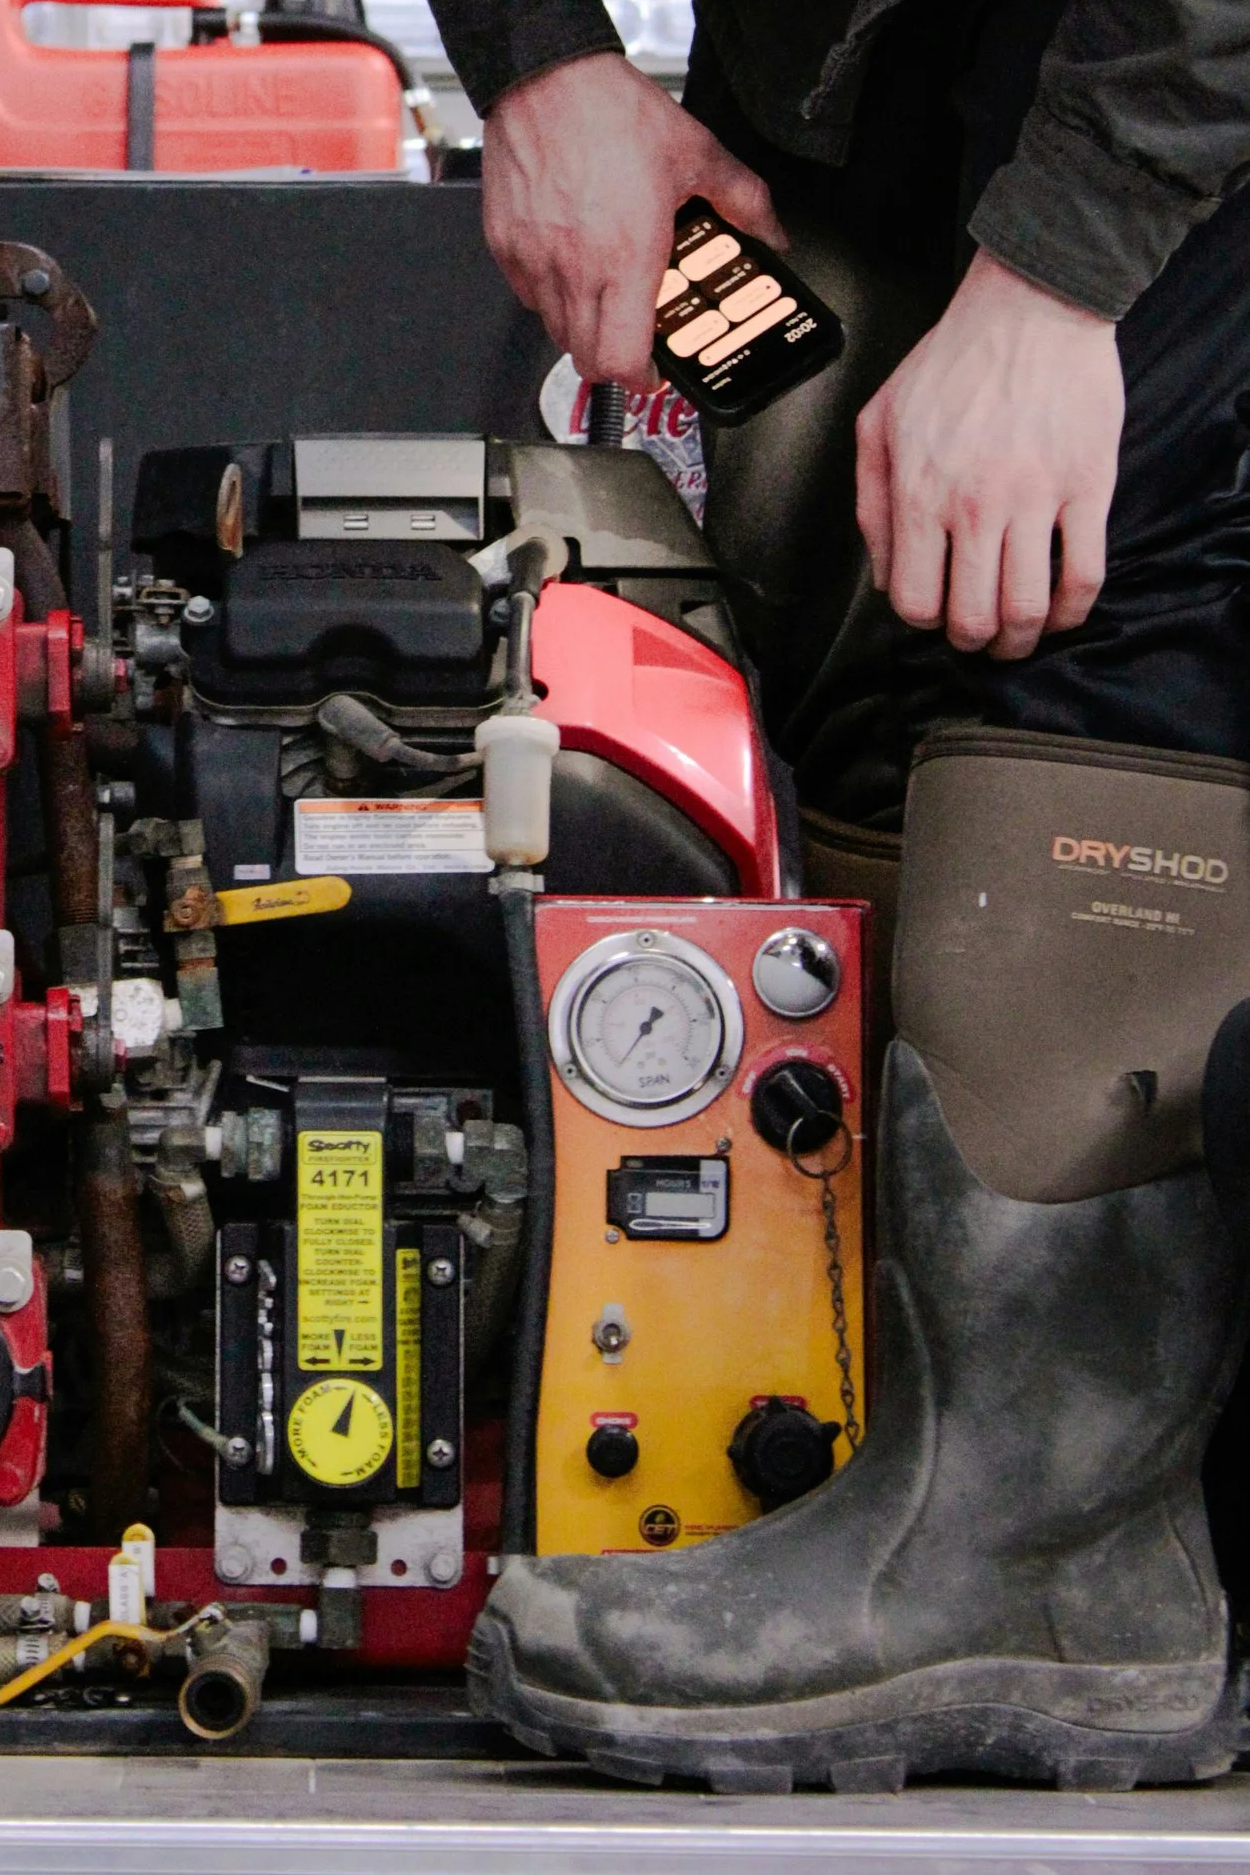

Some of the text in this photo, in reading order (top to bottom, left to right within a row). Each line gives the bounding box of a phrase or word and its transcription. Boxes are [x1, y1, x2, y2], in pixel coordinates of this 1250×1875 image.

[81, 73, 300, 118] GSOLINE
[784, 318, 817, 343] 20:02
[257, 562, 443, 582] HONDA
[1052, 836, 1229, 884] DRYSHOD
[1091, 901, 1163, 922] OVERLAND
[637, 1075, 671, 1088] SPAN
[826, 1063, 850, 1099] START
[311, 1169, 369, 1187] 4171
[301, 1333, 330, 1341] MORE
[351, 1333, 376, 1341] LESS
[293, 1384, 331, 1459] MORE FOAM
[356, 1444, 386, 1475] FOAM
